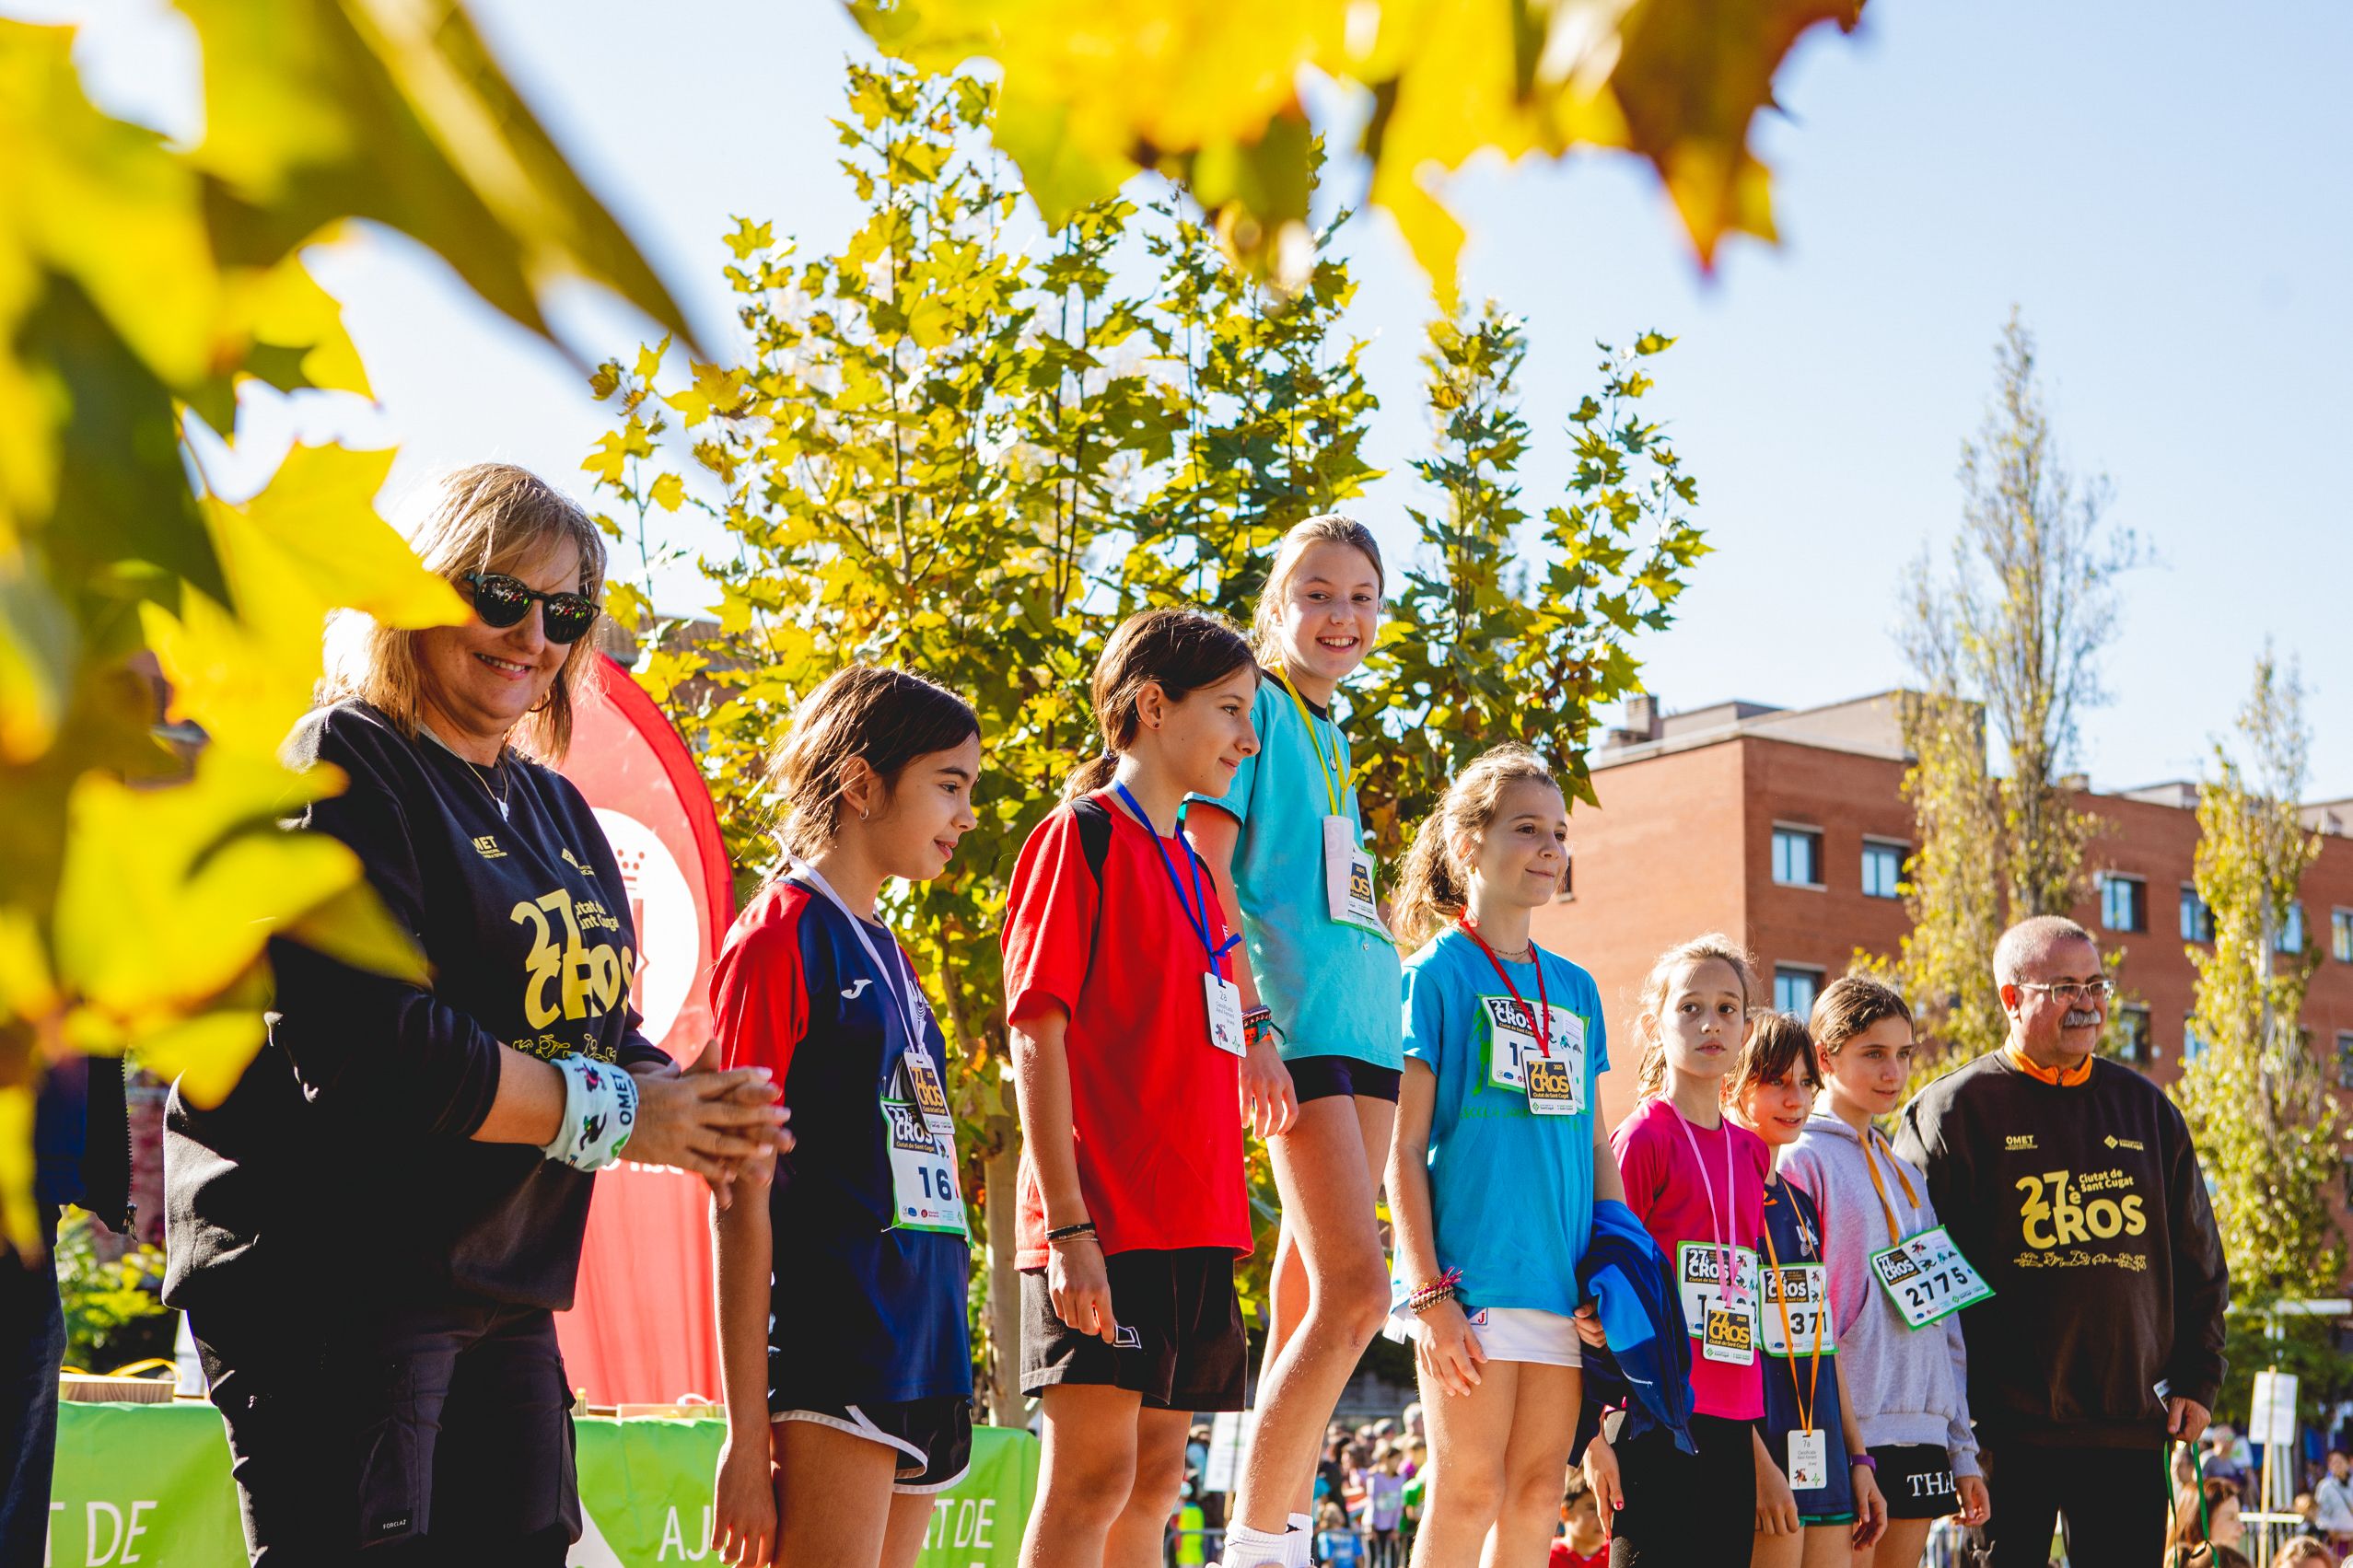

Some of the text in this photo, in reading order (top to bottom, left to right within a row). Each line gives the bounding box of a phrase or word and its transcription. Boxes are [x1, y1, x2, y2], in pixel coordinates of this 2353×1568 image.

[1531, 1074, 1570, 1093] CROS
[610, 1071, 633, 1125] OMET
[916, 1085, 944, 1107] CROS
[896, 1117, 933, 1144] CROS
[2006, 1135, 2033, 1144] OMET
[918, 1167, 952, 1201] 16
[2079, 1168, 2123, 1183] Ciutat de
[2080, 1176, 2135, 1192] Sant Cugat
[2022, 1194, 2147, 1249] CROS
[1884, 1260, 1915, 1280] CROS
[1905, 1267, 1968, 1307] 2775
[1708, 1322, 1750, 1343] CROS
[86, 1501, 157, 1567] DE
[954, 1499, 996, 1548] DE
